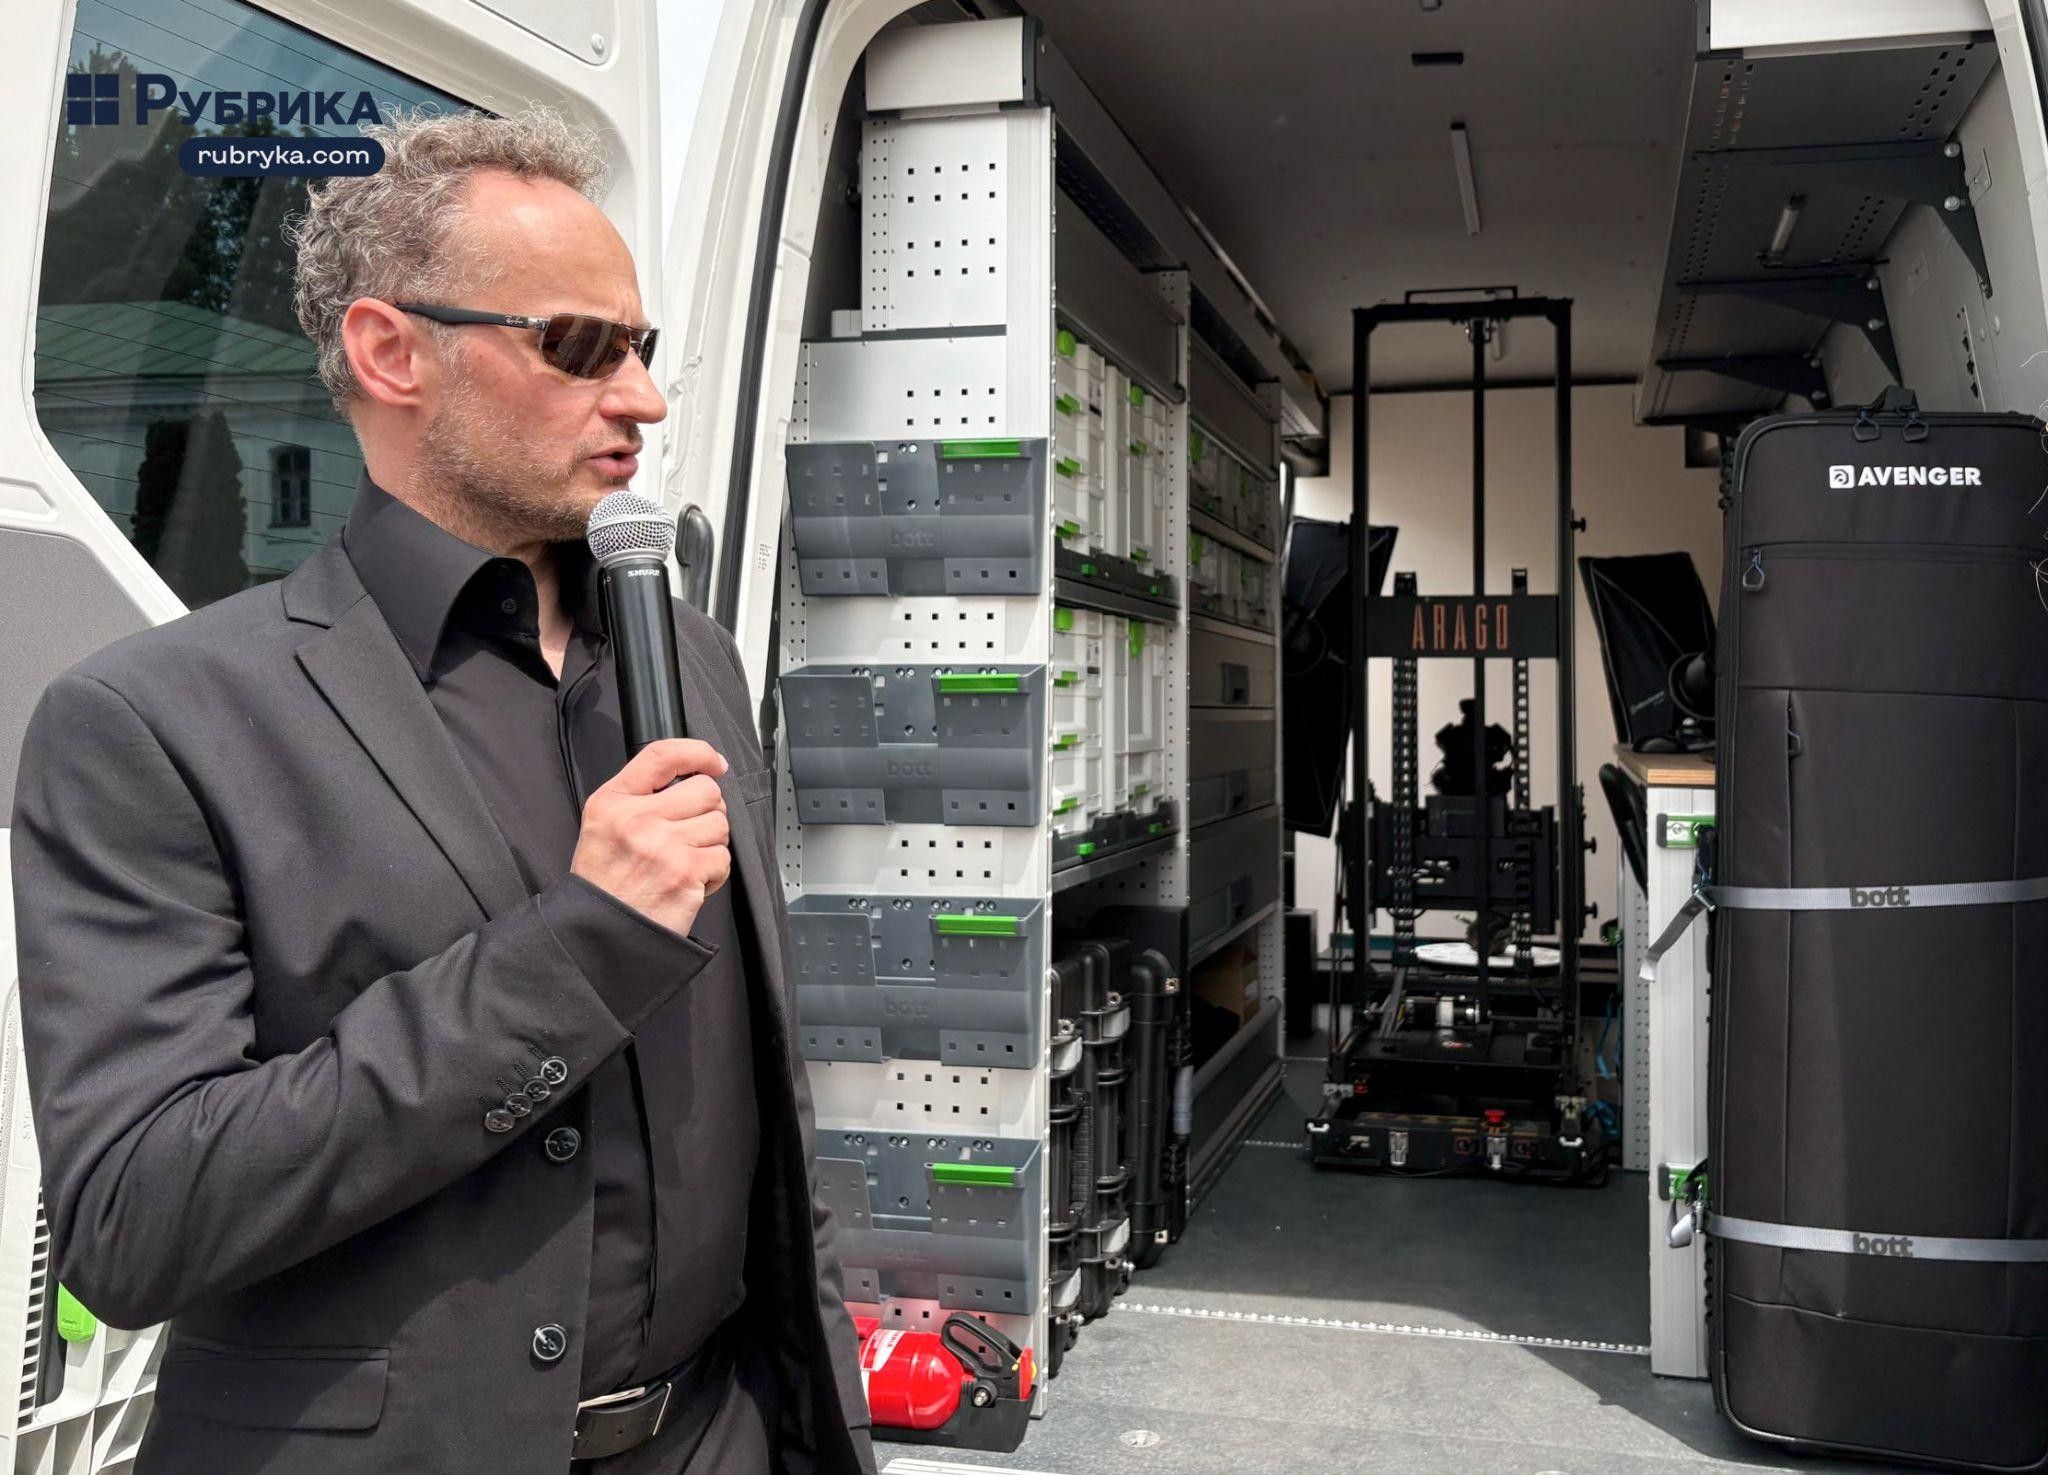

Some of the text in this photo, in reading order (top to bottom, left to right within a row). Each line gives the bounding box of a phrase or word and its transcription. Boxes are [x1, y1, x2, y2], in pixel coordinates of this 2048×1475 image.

[1857, 465, 1982, 487] AVENGER
[627, 568, 660, 577] SHURE
[1411, 603, 1508, 651] ARAGO
[1849, 885, 1911, 907] bott
[1852, 1232, 1914, 1257] bott
